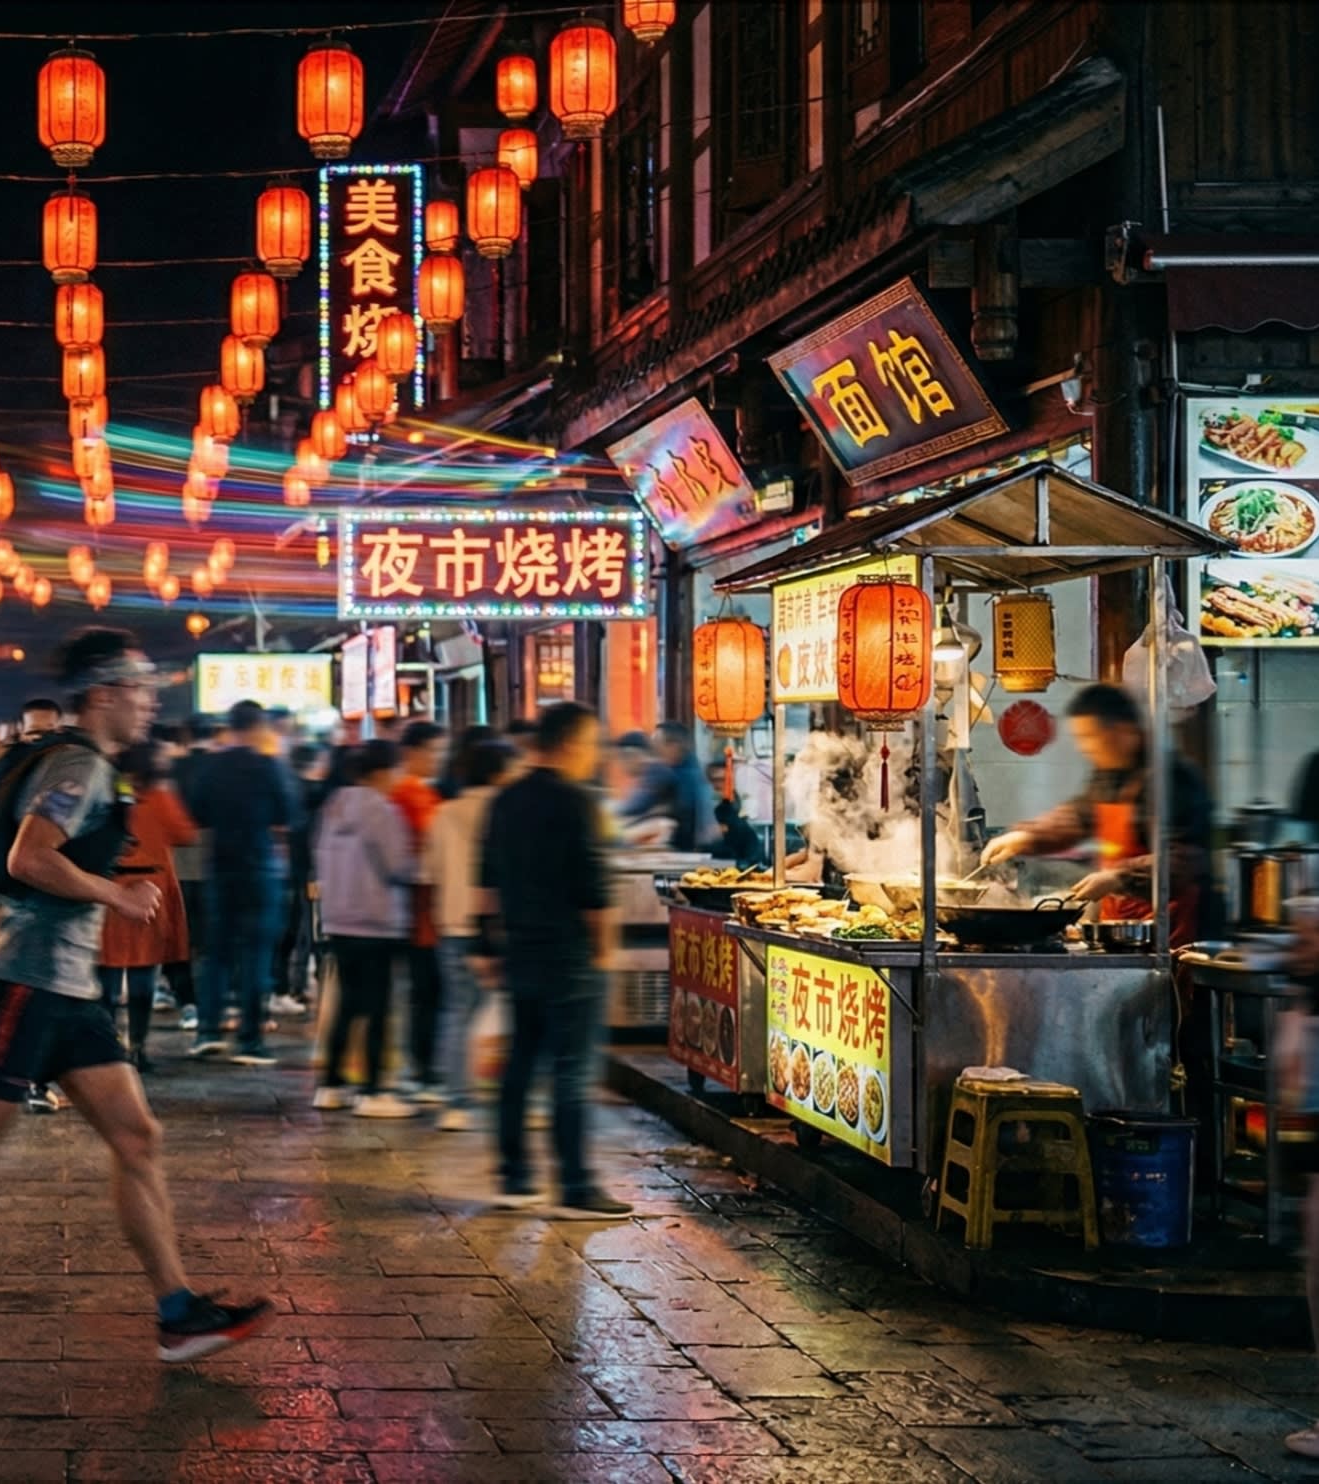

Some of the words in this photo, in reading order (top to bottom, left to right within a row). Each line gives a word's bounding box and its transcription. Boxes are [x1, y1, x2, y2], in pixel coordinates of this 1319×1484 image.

[341, 178, 402, 412] 美食烧
[811, 329, 955, 448] 面馆
[360, 527, 627, 599] 夜市烧烤
[673, 922, 734, 993] 夜市烧烤
[791, 962, 887, 1059] 夜市烧烤
